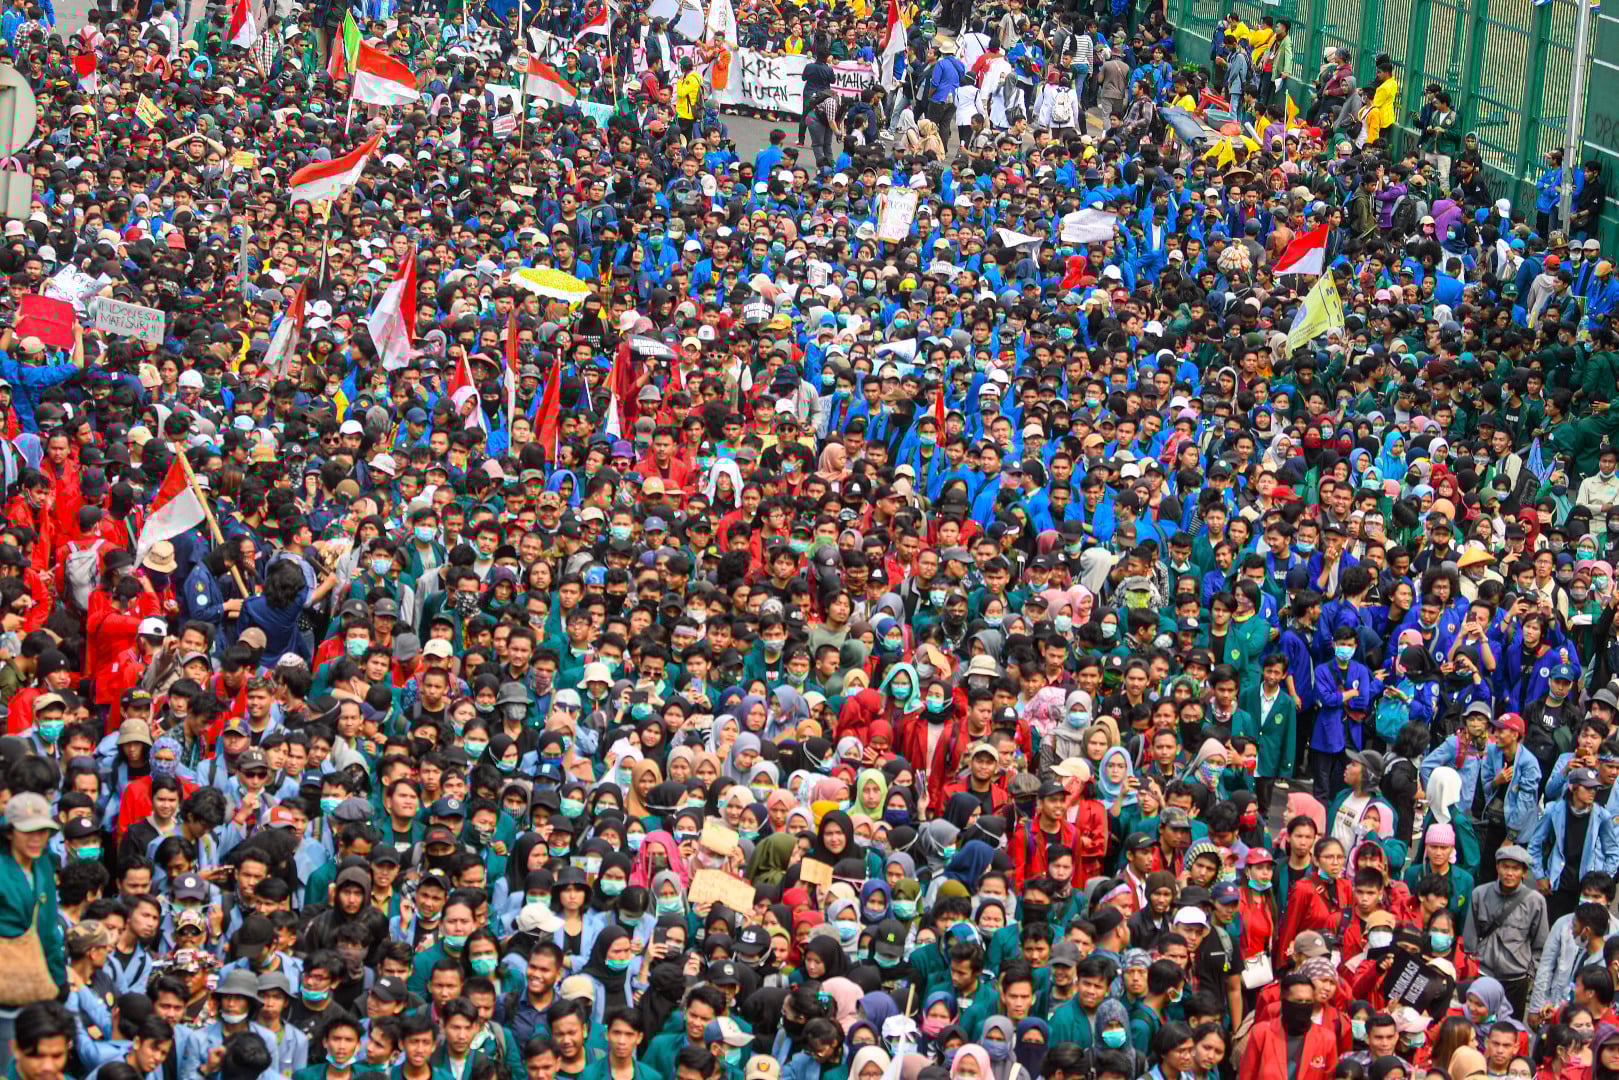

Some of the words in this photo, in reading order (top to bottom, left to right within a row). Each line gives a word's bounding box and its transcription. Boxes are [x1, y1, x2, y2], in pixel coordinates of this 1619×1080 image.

[741, 55, 781, 80] KPK
[741, 81, 788, 102] HUTAN
[835, 72, 882, 90] MAHKA
[98, 300, 161, 322] INDONESIA
[1388, 960, 1420, 1000] DEMOKRASI
[1404, 973, 1430, 1005] DIKEBIRI
